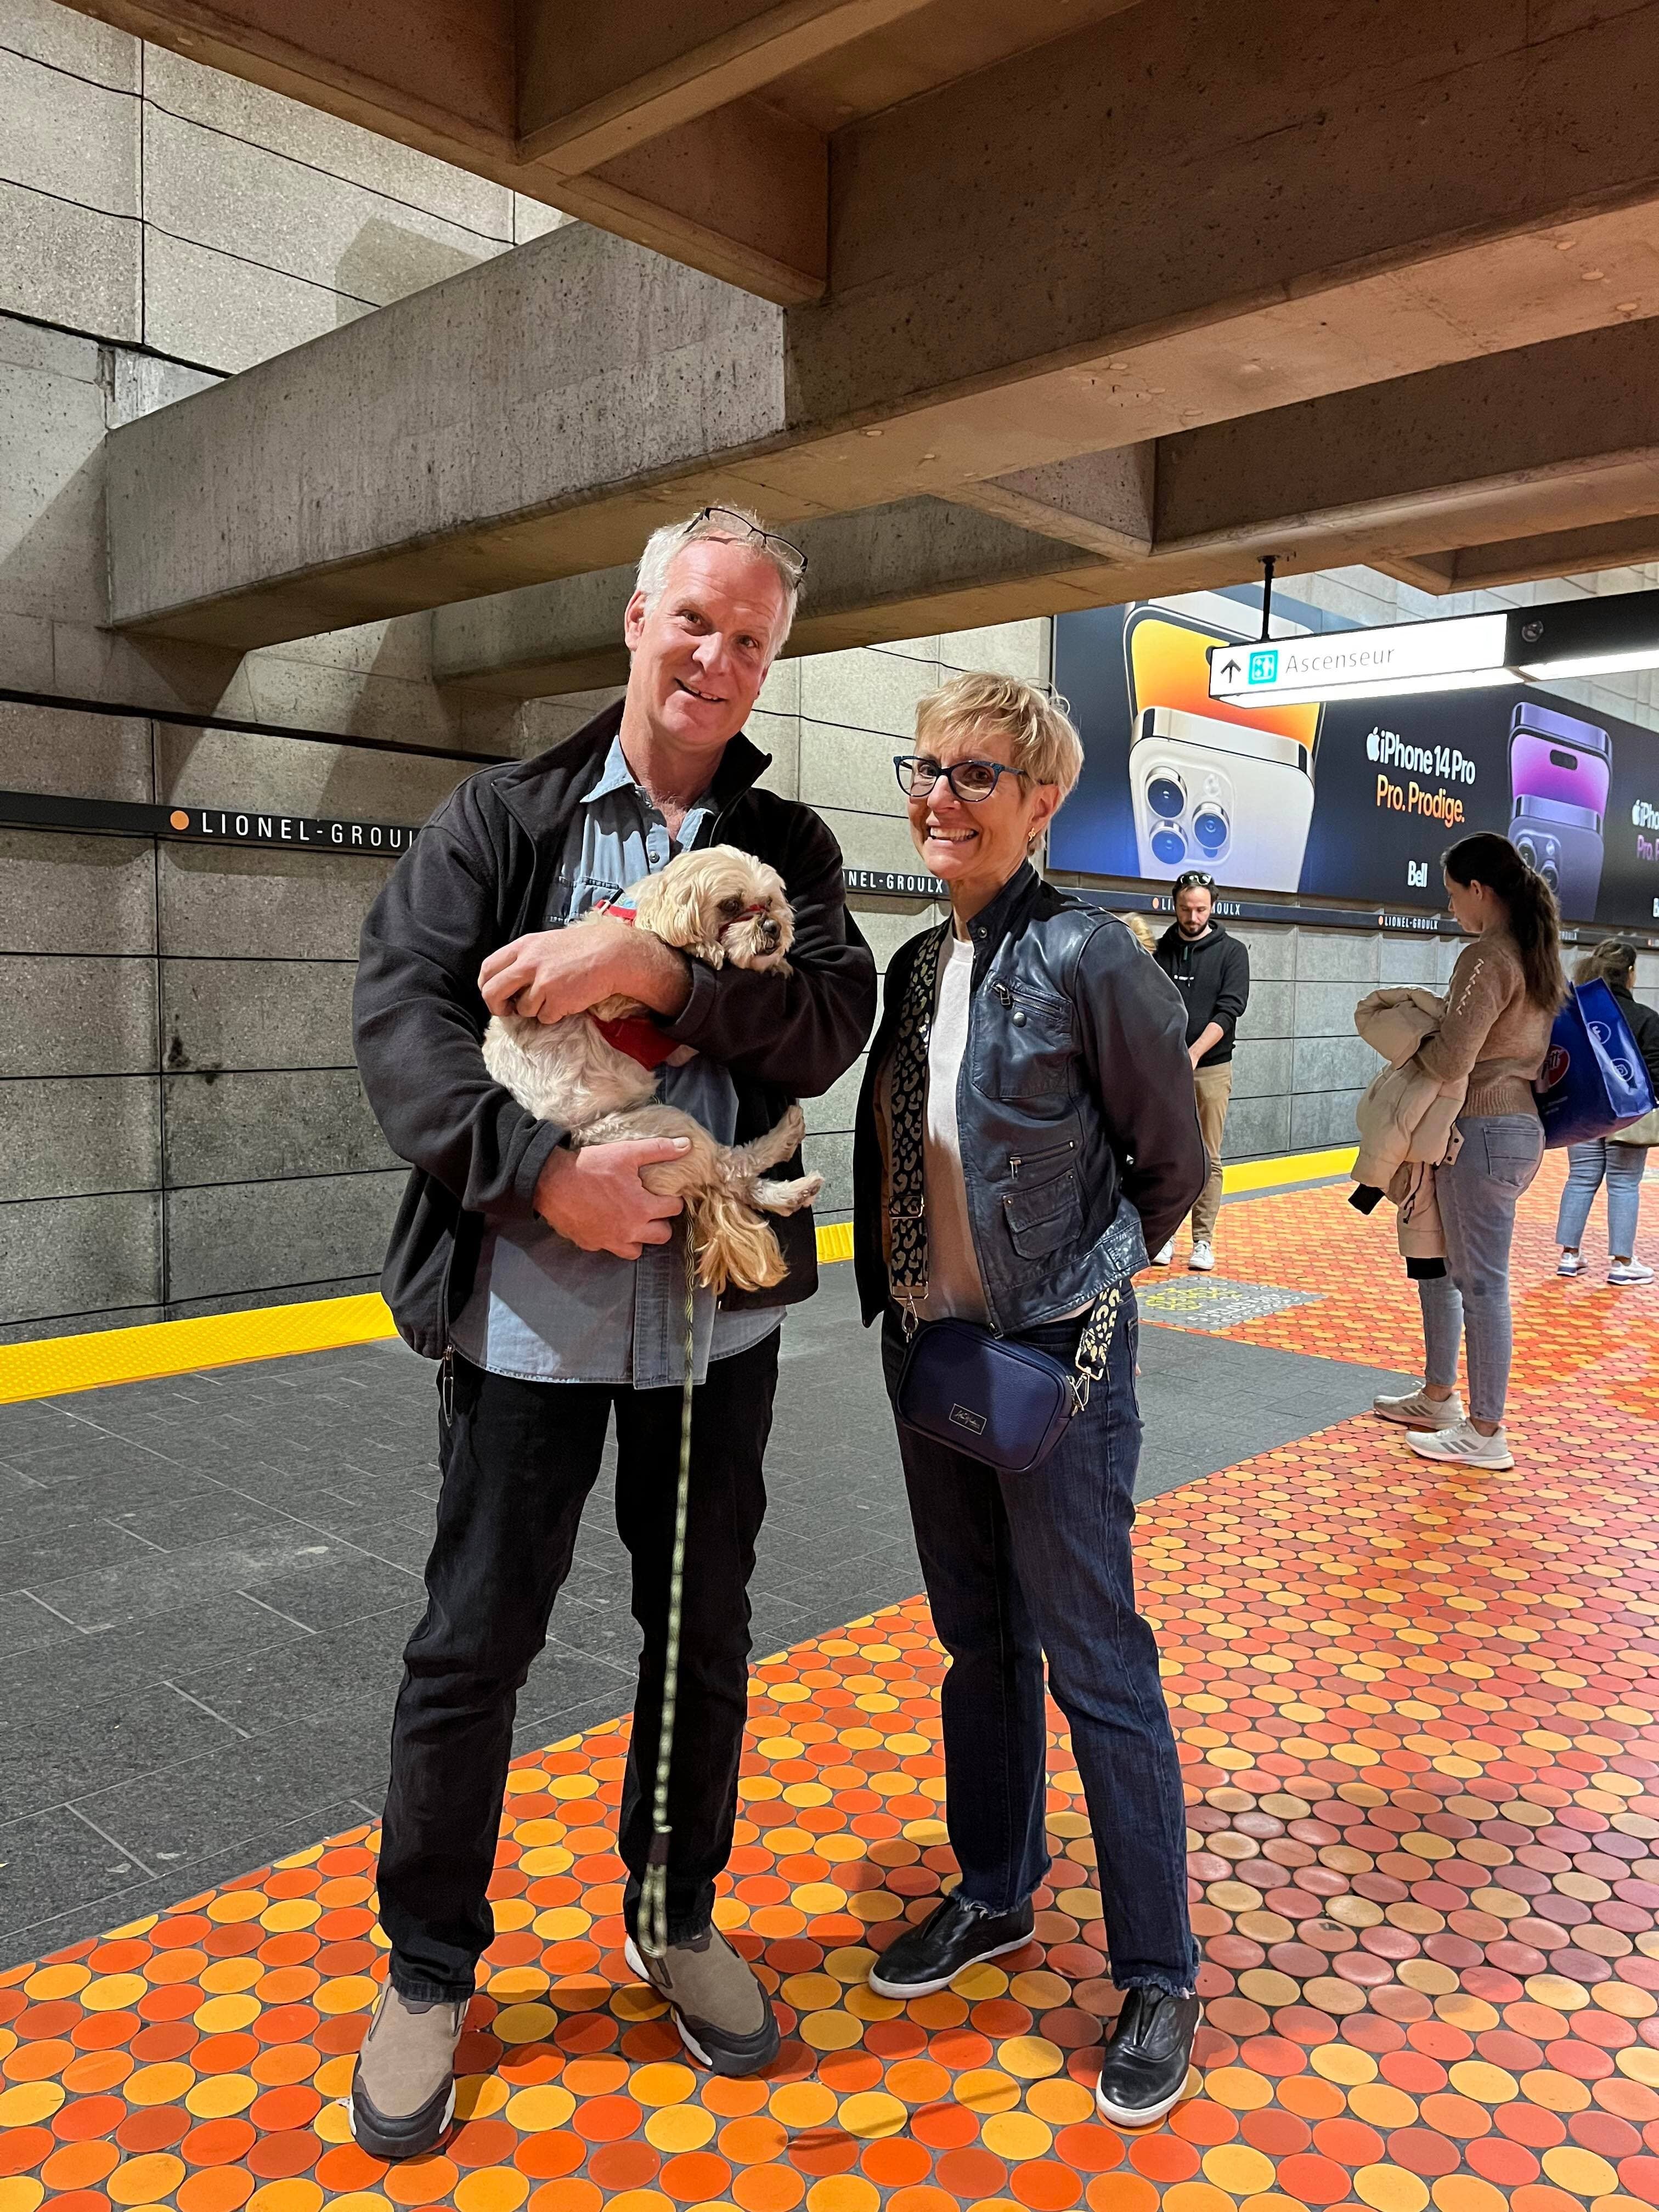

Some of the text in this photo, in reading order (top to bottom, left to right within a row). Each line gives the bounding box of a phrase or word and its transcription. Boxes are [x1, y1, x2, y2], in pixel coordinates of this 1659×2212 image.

[1285, 649, 1395, 674] Ascenseur
[1380, 730, 1476, 785] iPhone 14 Pro
[1377, 774, 1465, 828] Pro. Prodige.
[843, 870, 943, 894] NEL-GROULX
[1408, 860, 1428, 888] Bell
[1384, 916, 1438, 930] LIONEL-GROULX
